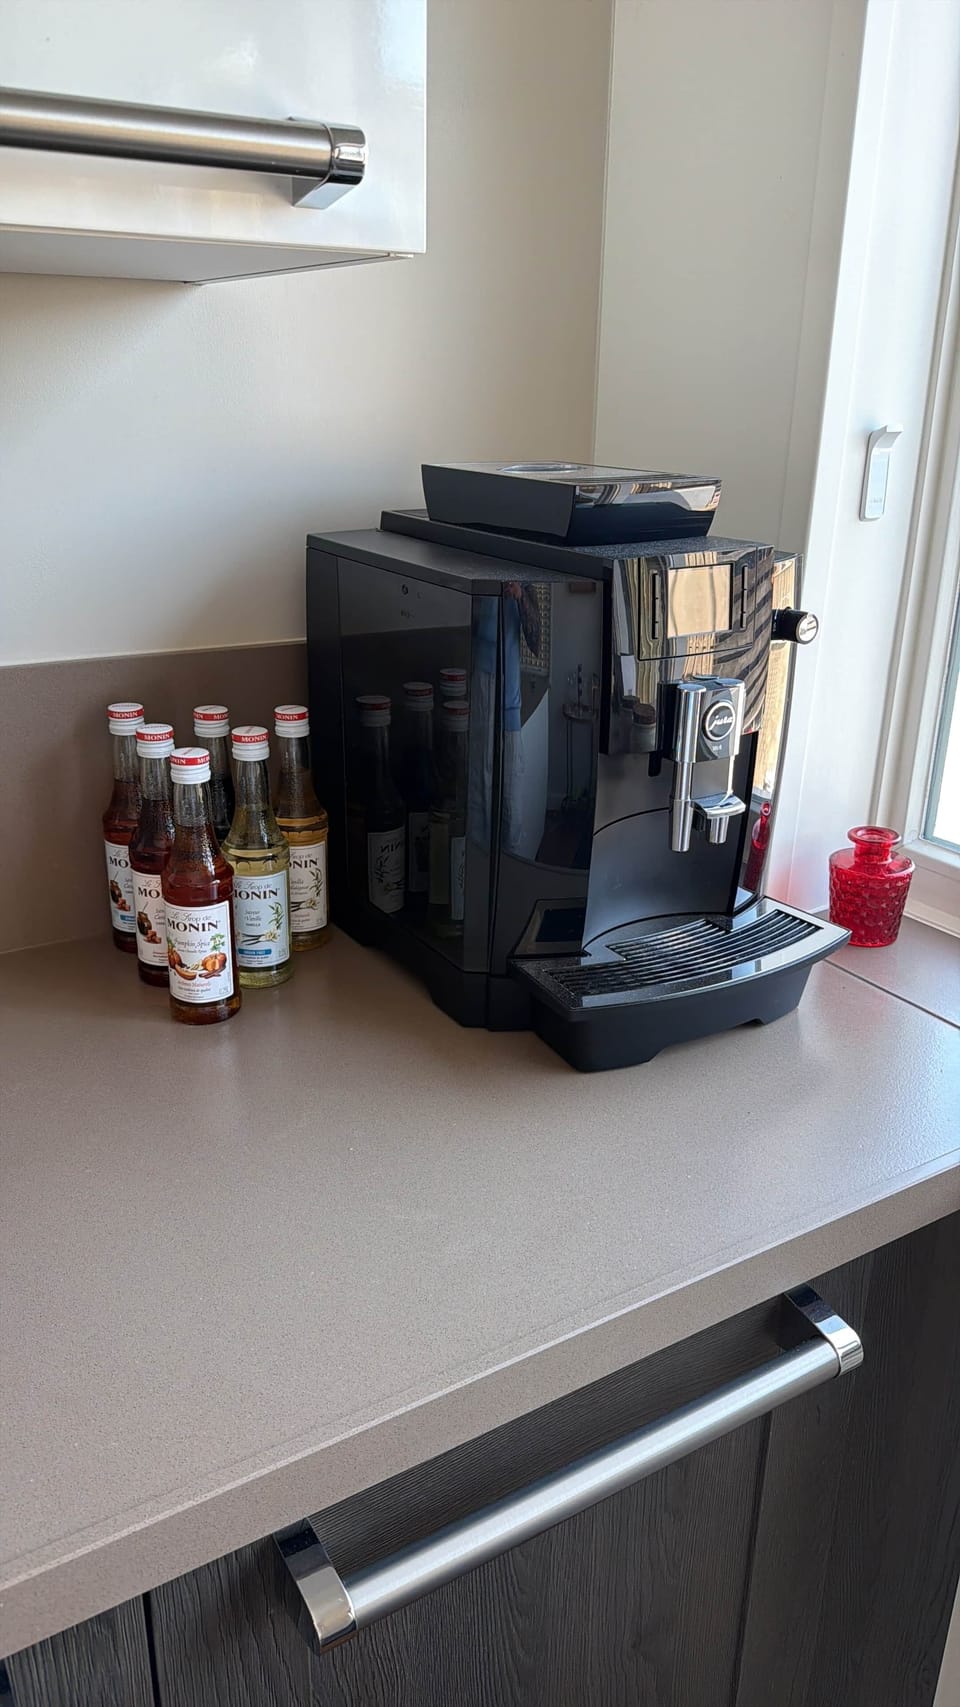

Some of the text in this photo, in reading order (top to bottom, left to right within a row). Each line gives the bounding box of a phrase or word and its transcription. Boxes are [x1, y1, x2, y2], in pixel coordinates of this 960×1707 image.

[143, 733, 170, 741] MONIN
[289, 858, 318, 869] NIN
[181, 912, 202, 923] Sirop
[167, 918, 218, 932] MONIN
